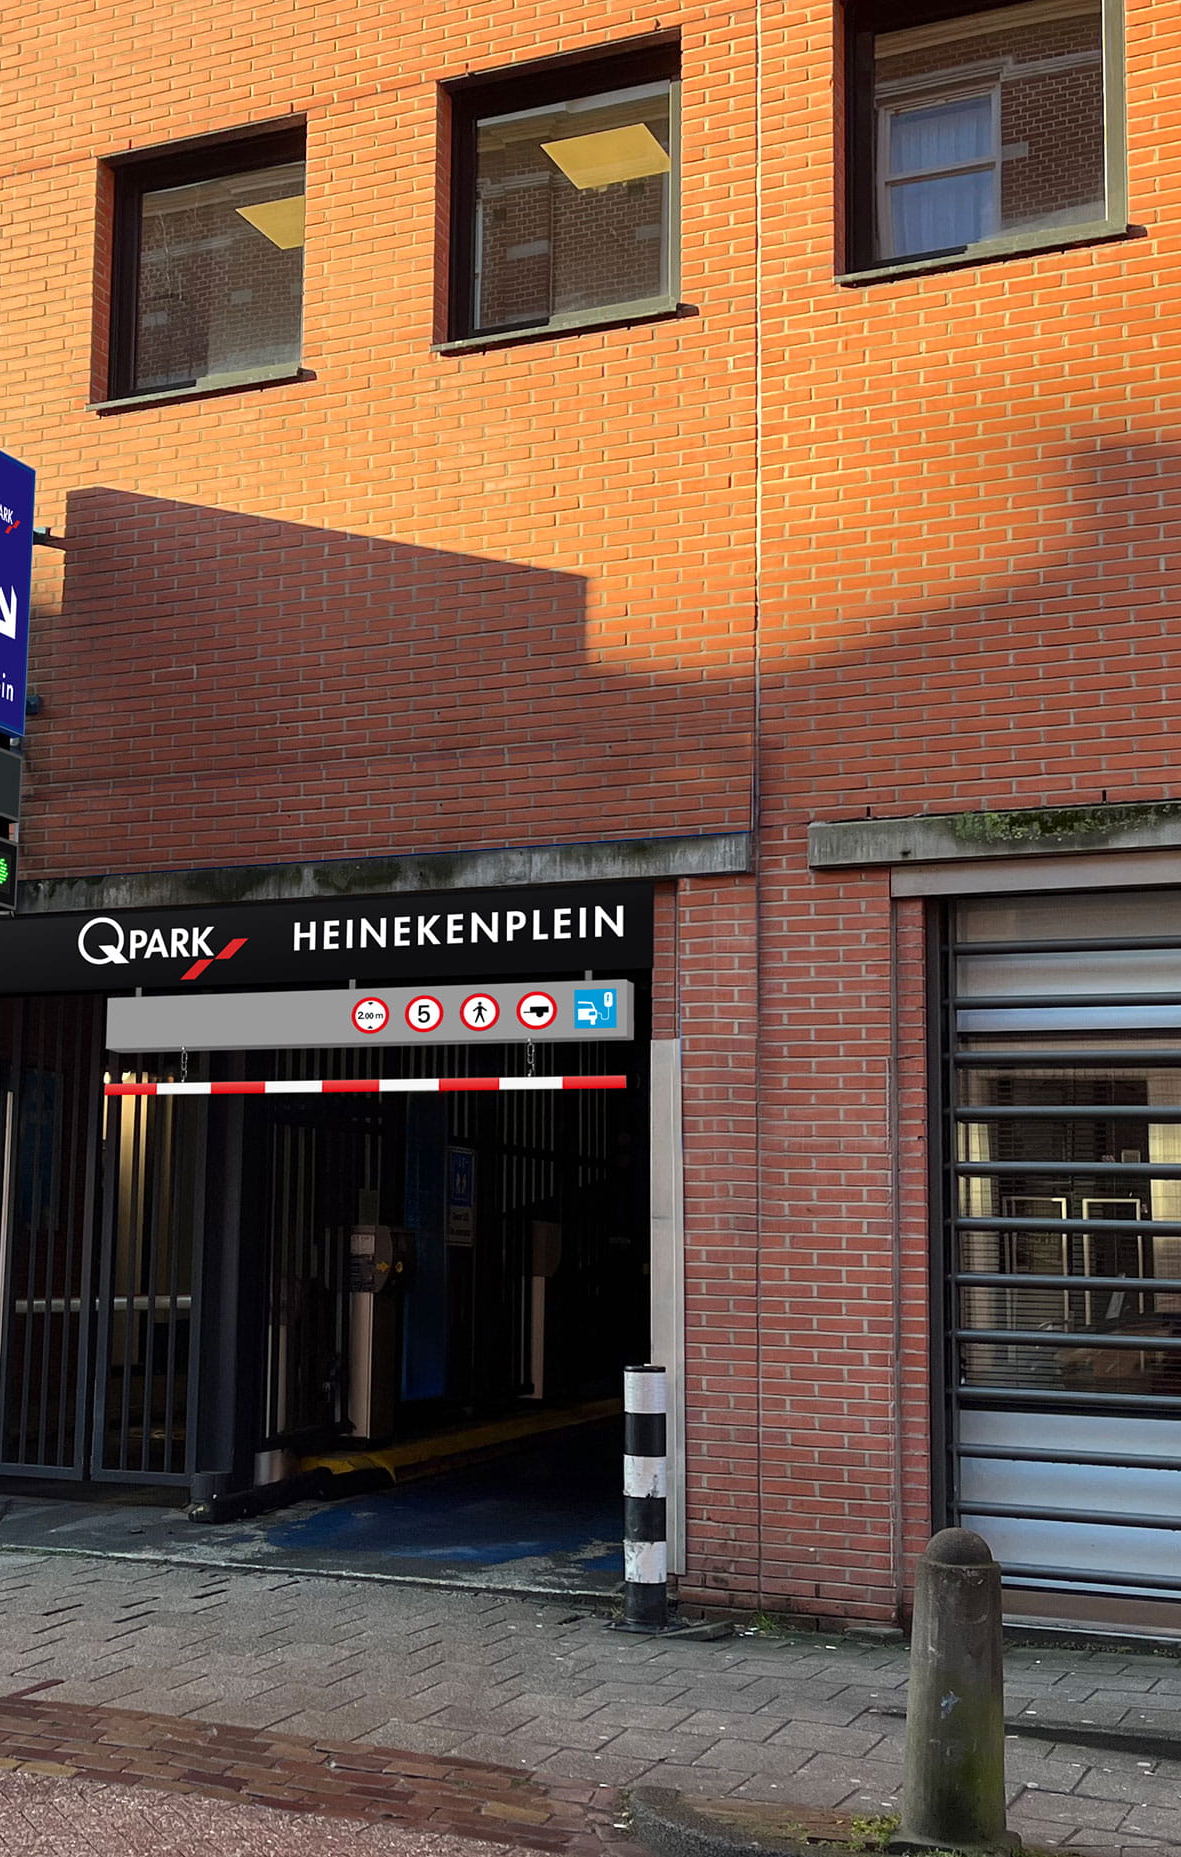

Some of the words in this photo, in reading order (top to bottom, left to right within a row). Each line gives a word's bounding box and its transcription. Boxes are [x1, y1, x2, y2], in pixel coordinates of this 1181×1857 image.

[292, 904, 625, 953] HEINEKENPLEIN
[357, 1011, 374, 1020] 2.00
[417, 1004, 431, 1024] 5
